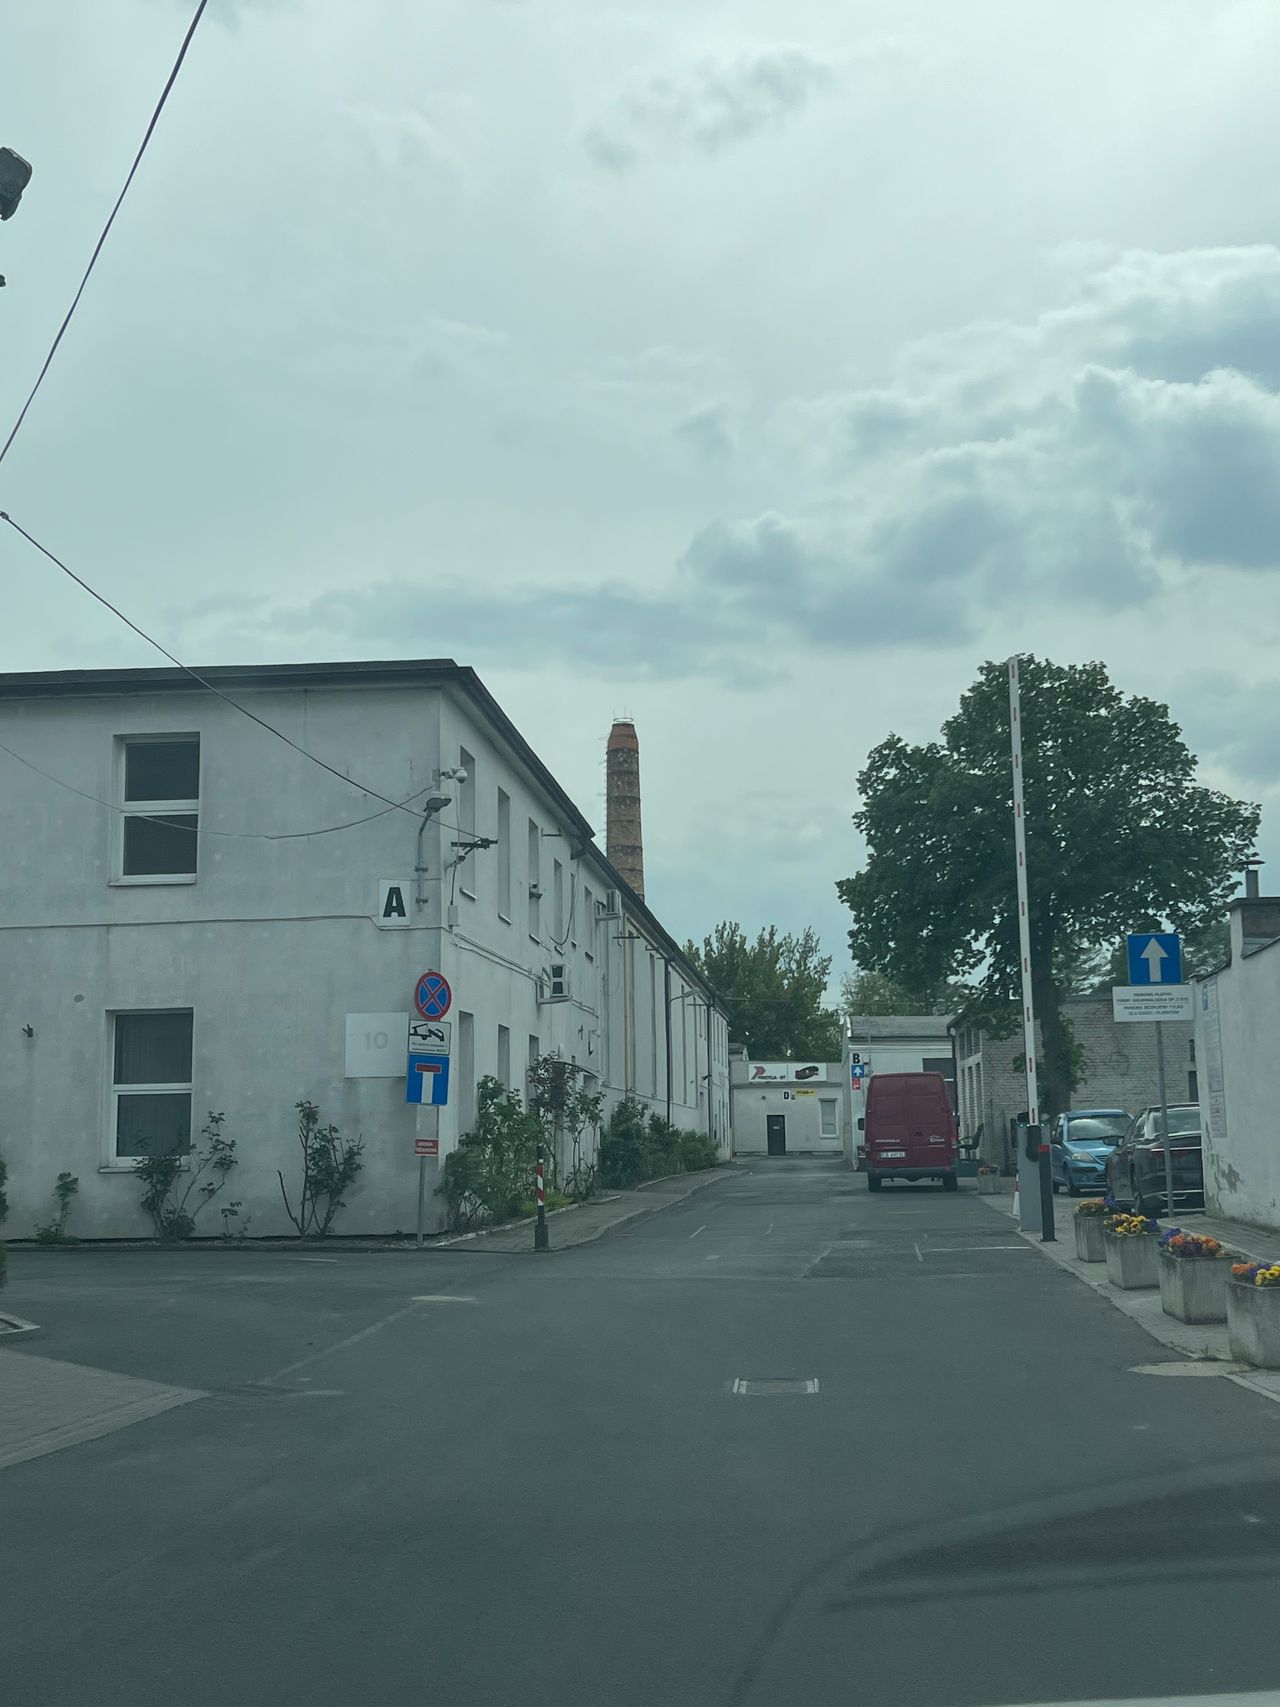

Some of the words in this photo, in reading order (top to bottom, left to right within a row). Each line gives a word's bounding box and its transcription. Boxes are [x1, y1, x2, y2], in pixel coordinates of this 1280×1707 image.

[383, 886, 407, 918] A
[365, 1031, 389, 1051] 10
[852, 1053, 861, 1064] B
[783, 1091, 790, 1100] D
